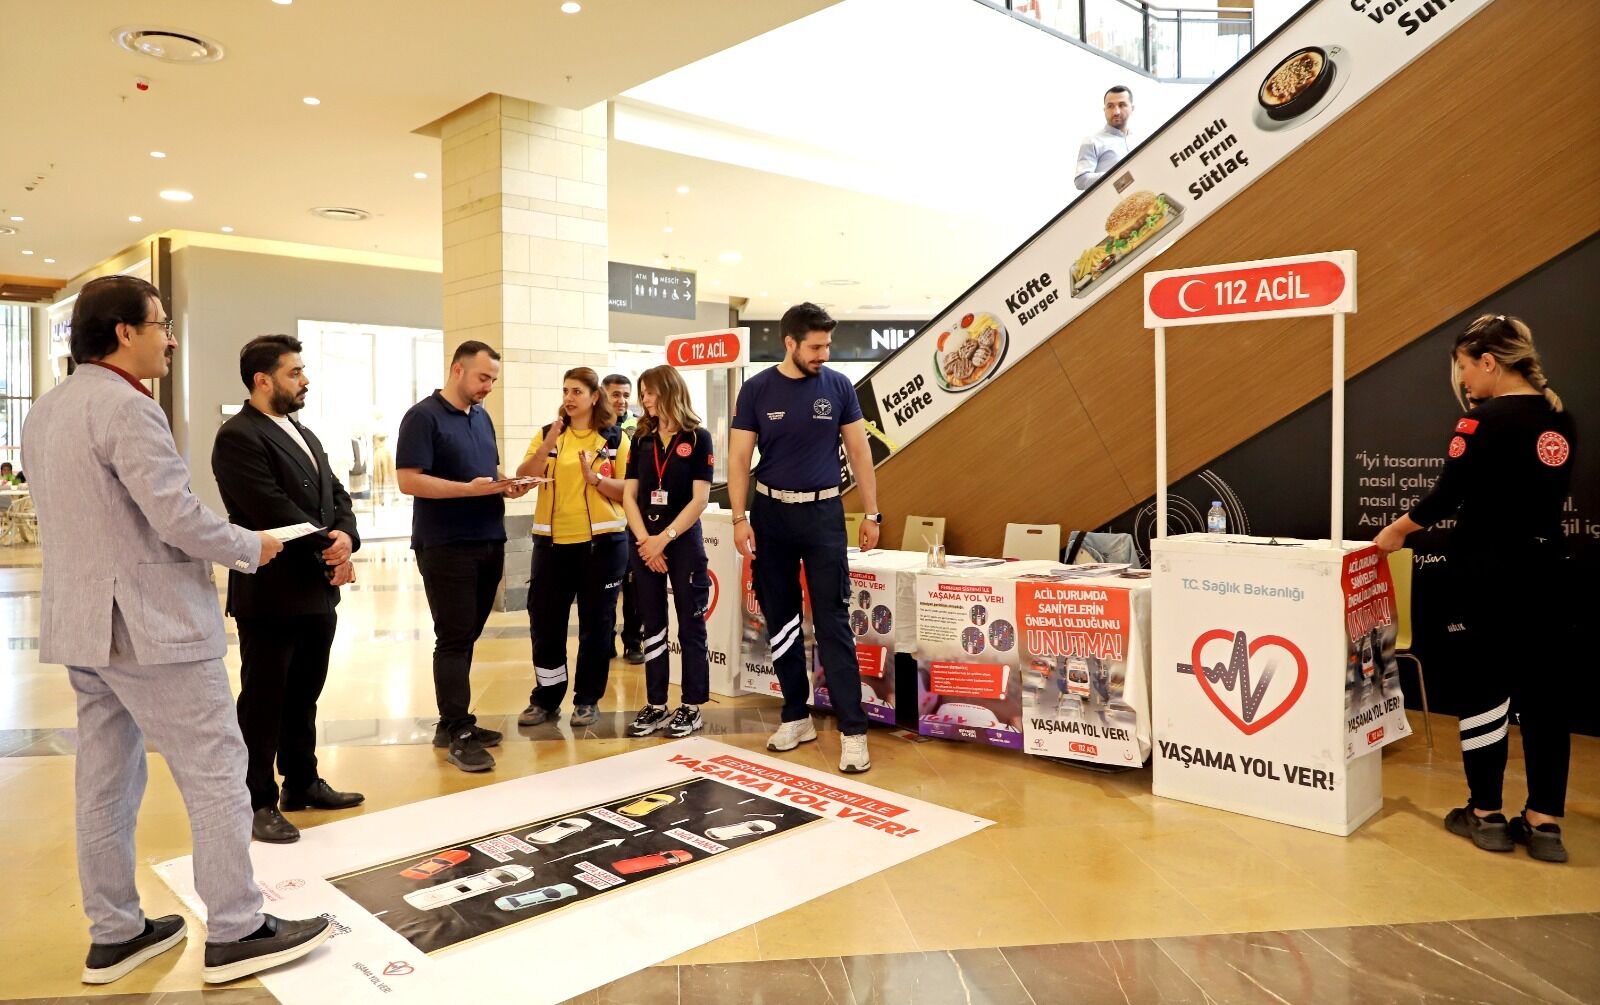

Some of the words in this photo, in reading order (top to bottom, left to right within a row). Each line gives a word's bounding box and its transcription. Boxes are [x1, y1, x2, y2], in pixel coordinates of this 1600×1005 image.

[1169, 118, 1228, 168] Fındıklı
[1199, 133, 1238, 166] Fırın
[1188, 149, 1249, 200] Sütlaç
[1005, 272, 1052, 314] Köfte
[1214, 280, 1247, 306] 112
[1255, 271, 1310, 302] ACİL
[1017, 289, 1060, 327] Burger
[692, 344, 704, 359] 112
[706, 339, 728, 358] ACİL
[881, 373, 925, 412] Kasap
[893, 390, 933, 427] Köfte
[1384, 454, 1445, 468] tasarım
[1360, 473, 1396, 488] nasıl
[1360, 494, 1396, 508] nasıl
[1358, 513, 1387, 527] Asıl
[854, 580, 867, 588] YOL
[869, 582, 886, 590] VER!
[928, 591, 961, 602] YAŞAMA
[964, 594, 982, 602] YOL
[984, 595, 1004, 604] VER!
[1034, 588, 1056, 600] ACİL
[1057, 590, 1108, 602] DURUMDA
[1202, 580, 1240, 596] Sağlık
[1243, 584, 1304, 601] Bakanlığı
[1025, 614, 1062, 628] ÖNEMLİ
[1064, 616, 1120, 630] OLDUĞUNU
[1038, 601, 1104, 616] SANİYELERİN
[1027, 630, 1122, 662] UNUTMA!
[1348, 709, 1374, 734] YAŞAMA
[1372, 704, 1384, 720] YOL
[1384, 696, 1400, 714] VER!
[1030, 718, 1080, 734] YAŞAMA
[1081, 723, 1101, 738] YOL
[1102, 727, 1130, 741] VER!
[1158, 740, 1236, 773] YAŞAMA
[1240, 756, 1280, 780] YOL
[1284, 764, 1334, 792] VER!
[774, 788, 832, 812] YOL
[836, 806, 920, 838] VER!
